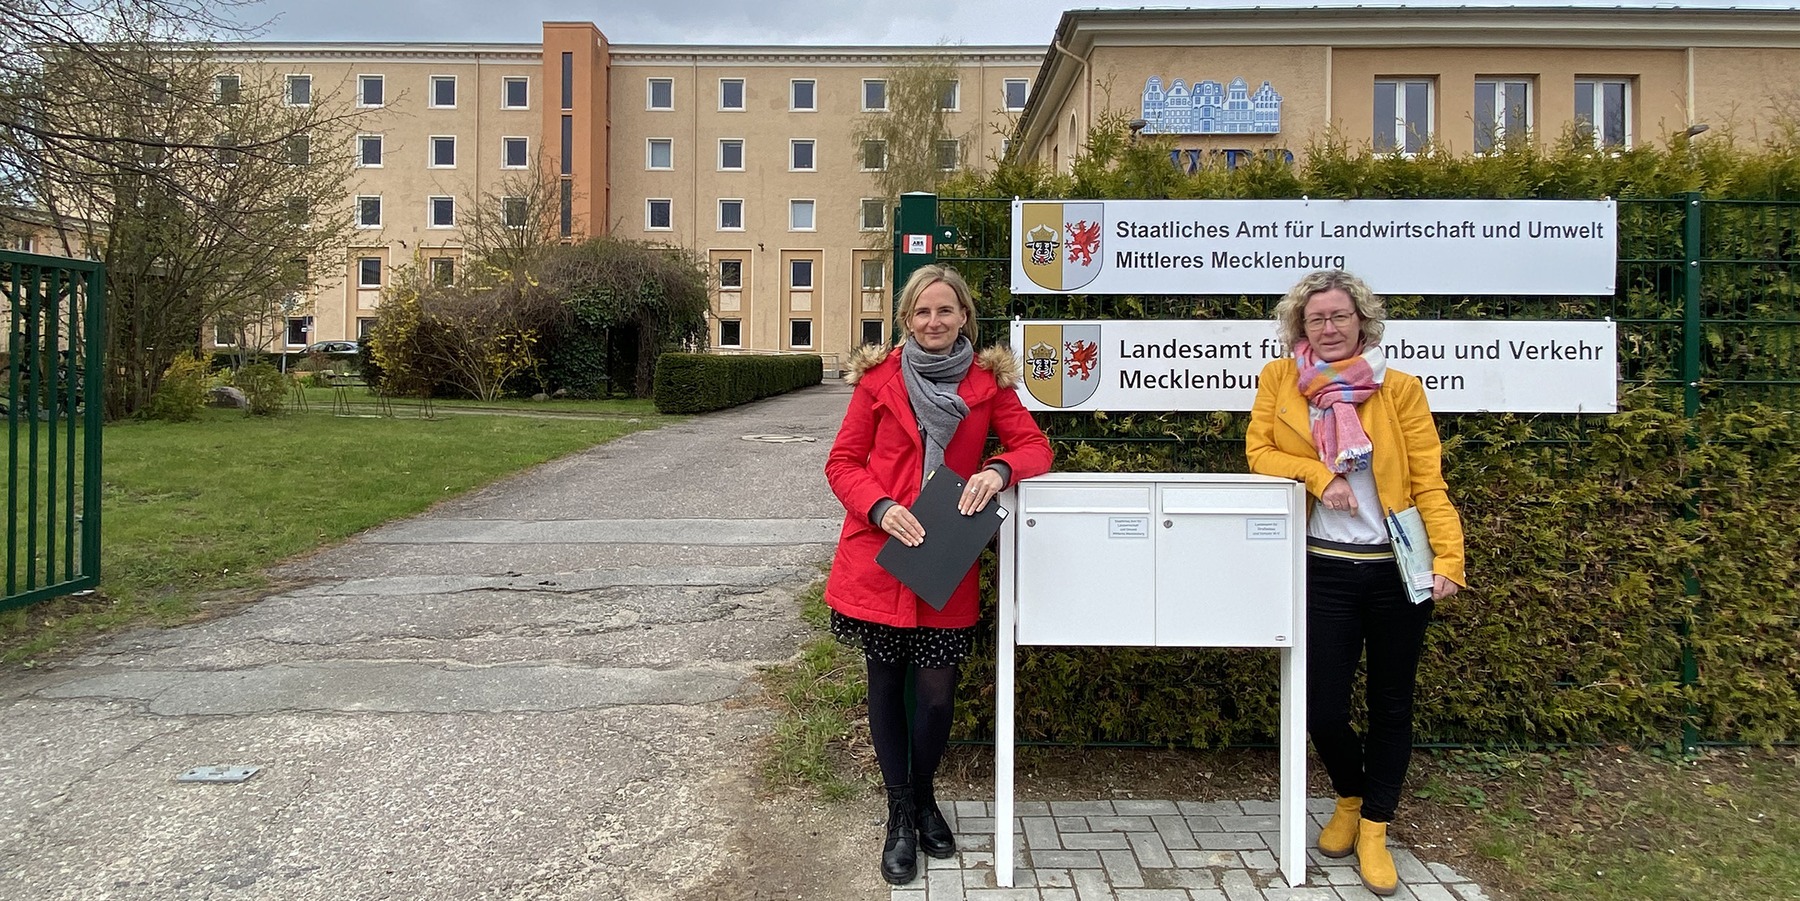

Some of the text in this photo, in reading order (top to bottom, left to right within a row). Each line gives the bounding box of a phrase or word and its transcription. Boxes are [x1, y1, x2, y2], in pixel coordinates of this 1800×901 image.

[1116, 220, 1604, 239] Staatliches Amt für Landwirtschaft und Umwelt
[1116, 251, 1345, 270] Mittleres Mecklenburg
[1120, 338, 1604, 361] Landesamt fü nbau und Verkehr
[1120, 368, 1259, 390] Mecklenbur
